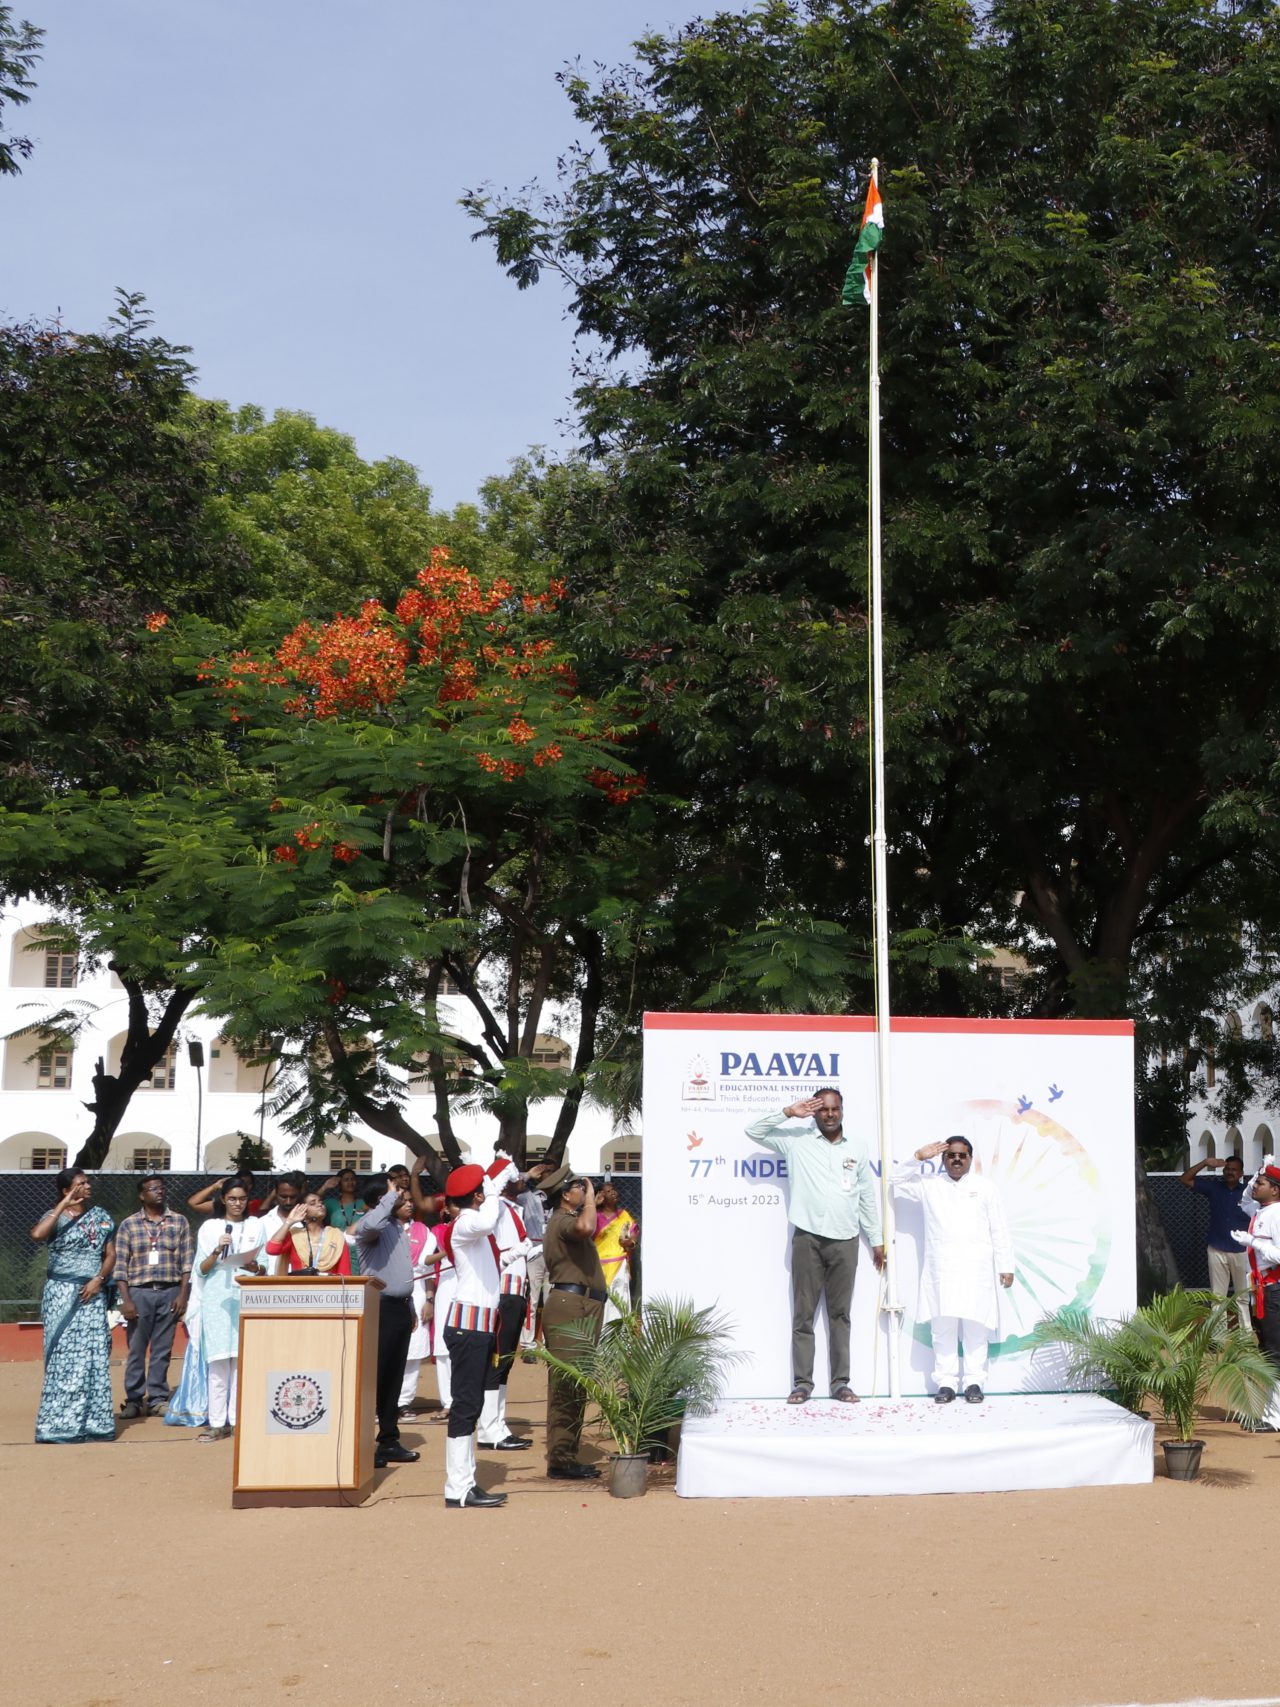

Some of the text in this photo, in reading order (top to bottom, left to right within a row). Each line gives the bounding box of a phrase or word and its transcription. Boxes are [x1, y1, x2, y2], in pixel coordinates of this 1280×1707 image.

[720, 1052, 840, 1077] PAAVAI
[720, 1084, 778, 1092] EDUCATIONAL
[720, 1094, 740, 1103] Think
[708, 1194, 748, 1208] August
[751, 1195, 780, 1206] 2023
[245, 1294, 360, 1304] PAAVAI ENGINEERING COLLEGE
